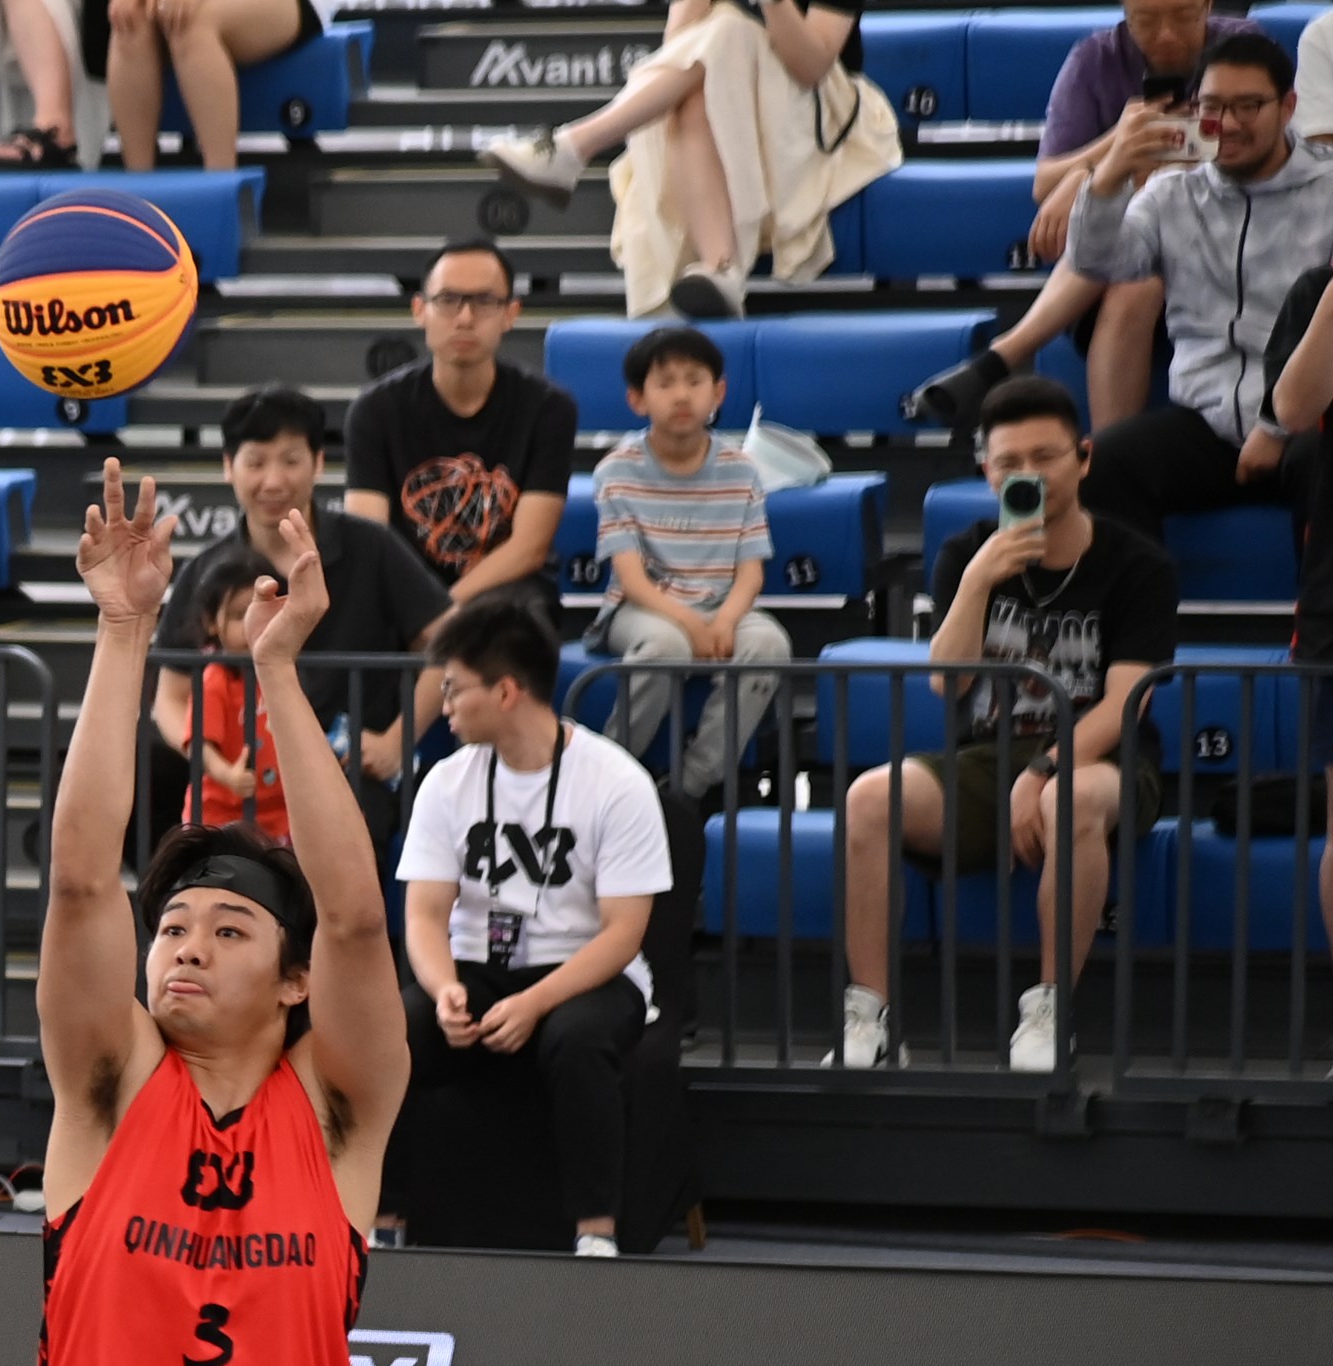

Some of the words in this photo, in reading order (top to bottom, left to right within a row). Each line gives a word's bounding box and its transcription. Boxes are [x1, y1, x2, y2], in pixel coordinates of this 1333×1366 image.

[2, 298, 136, 337] Wilson
[1197, 729, 1230, 759] 13
[124, 1215, 317, 1271] QINHUANGDAO
